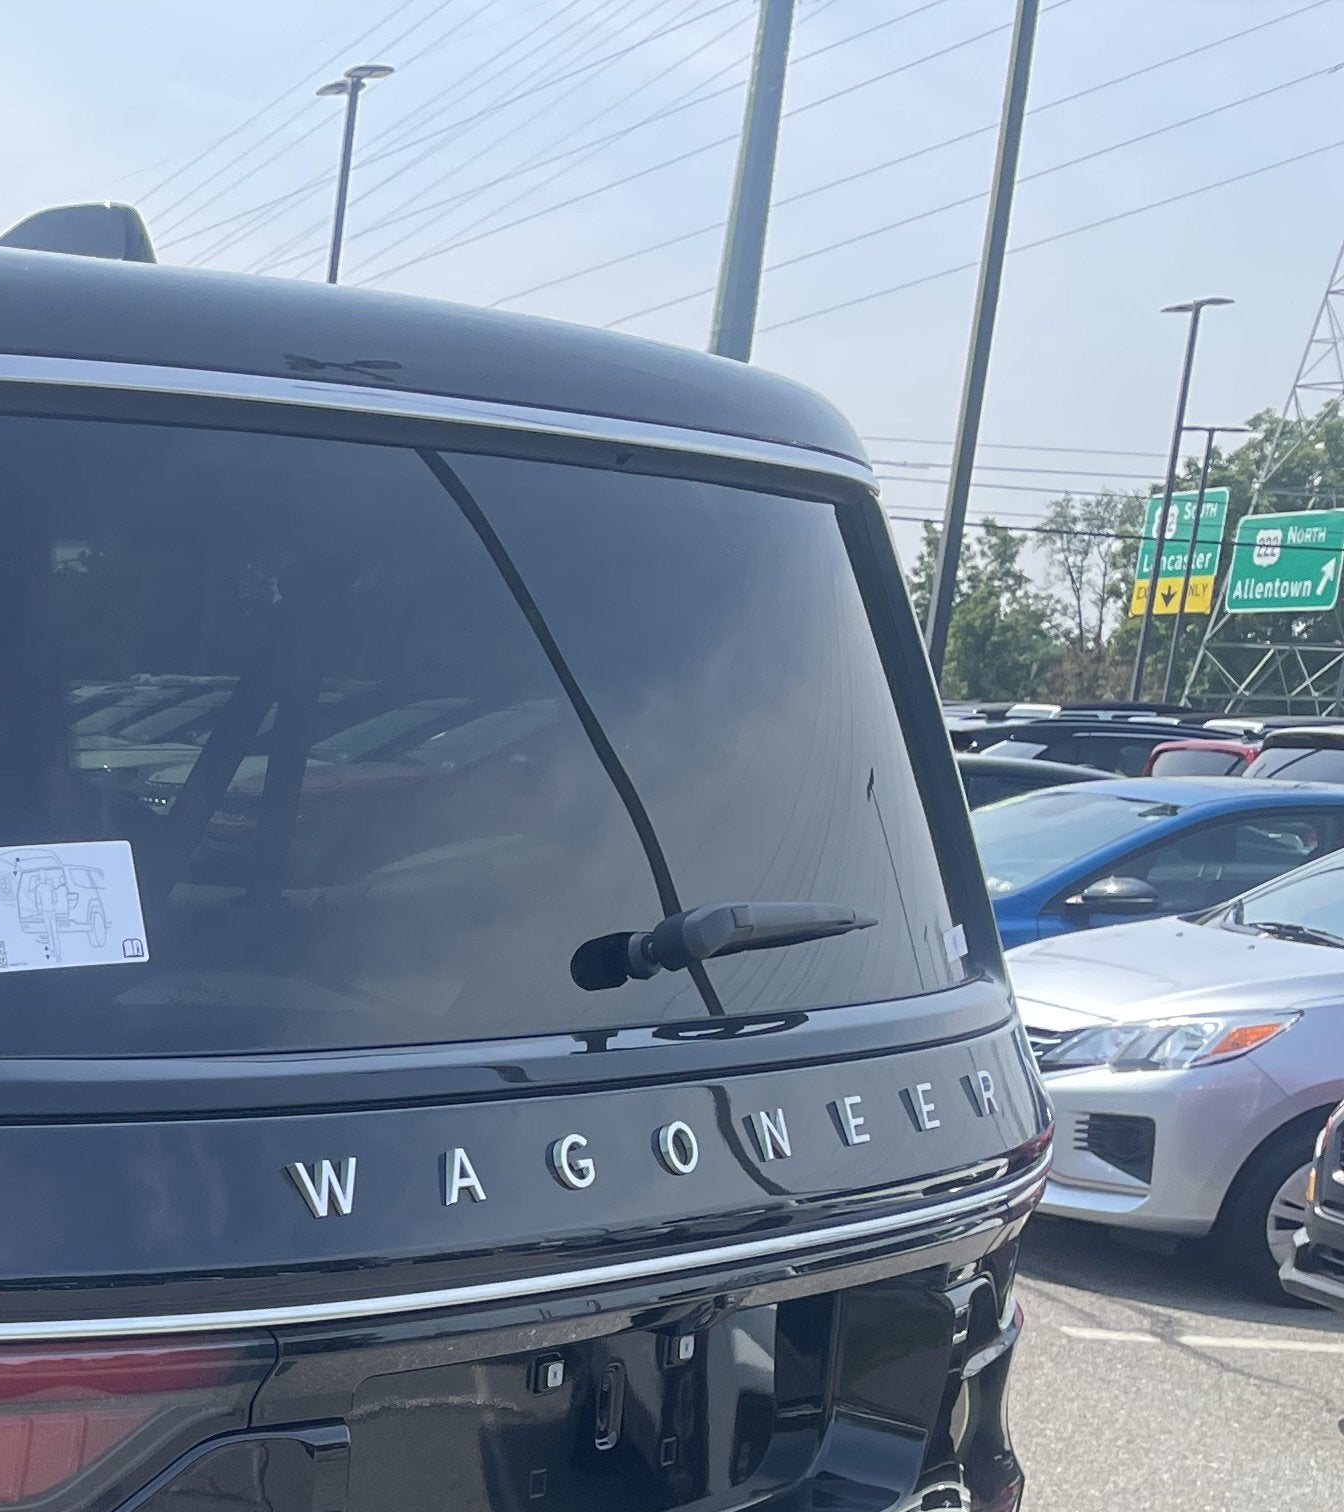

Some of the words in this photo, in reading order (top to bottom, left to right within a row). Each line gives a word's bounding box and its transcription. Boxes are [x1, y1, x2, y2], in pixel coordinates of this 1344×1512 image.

[1287, 525, 1327, 544] NORTH
[1257, 536, 1279, 558] 222
[1143, 552, 1213, 572] Lncaster
[1189, 583, 1209, 597] NLY
[1232, 578, 1312, 599] Allentown
[287, 1068, 1000, 1220] WAGONEER
